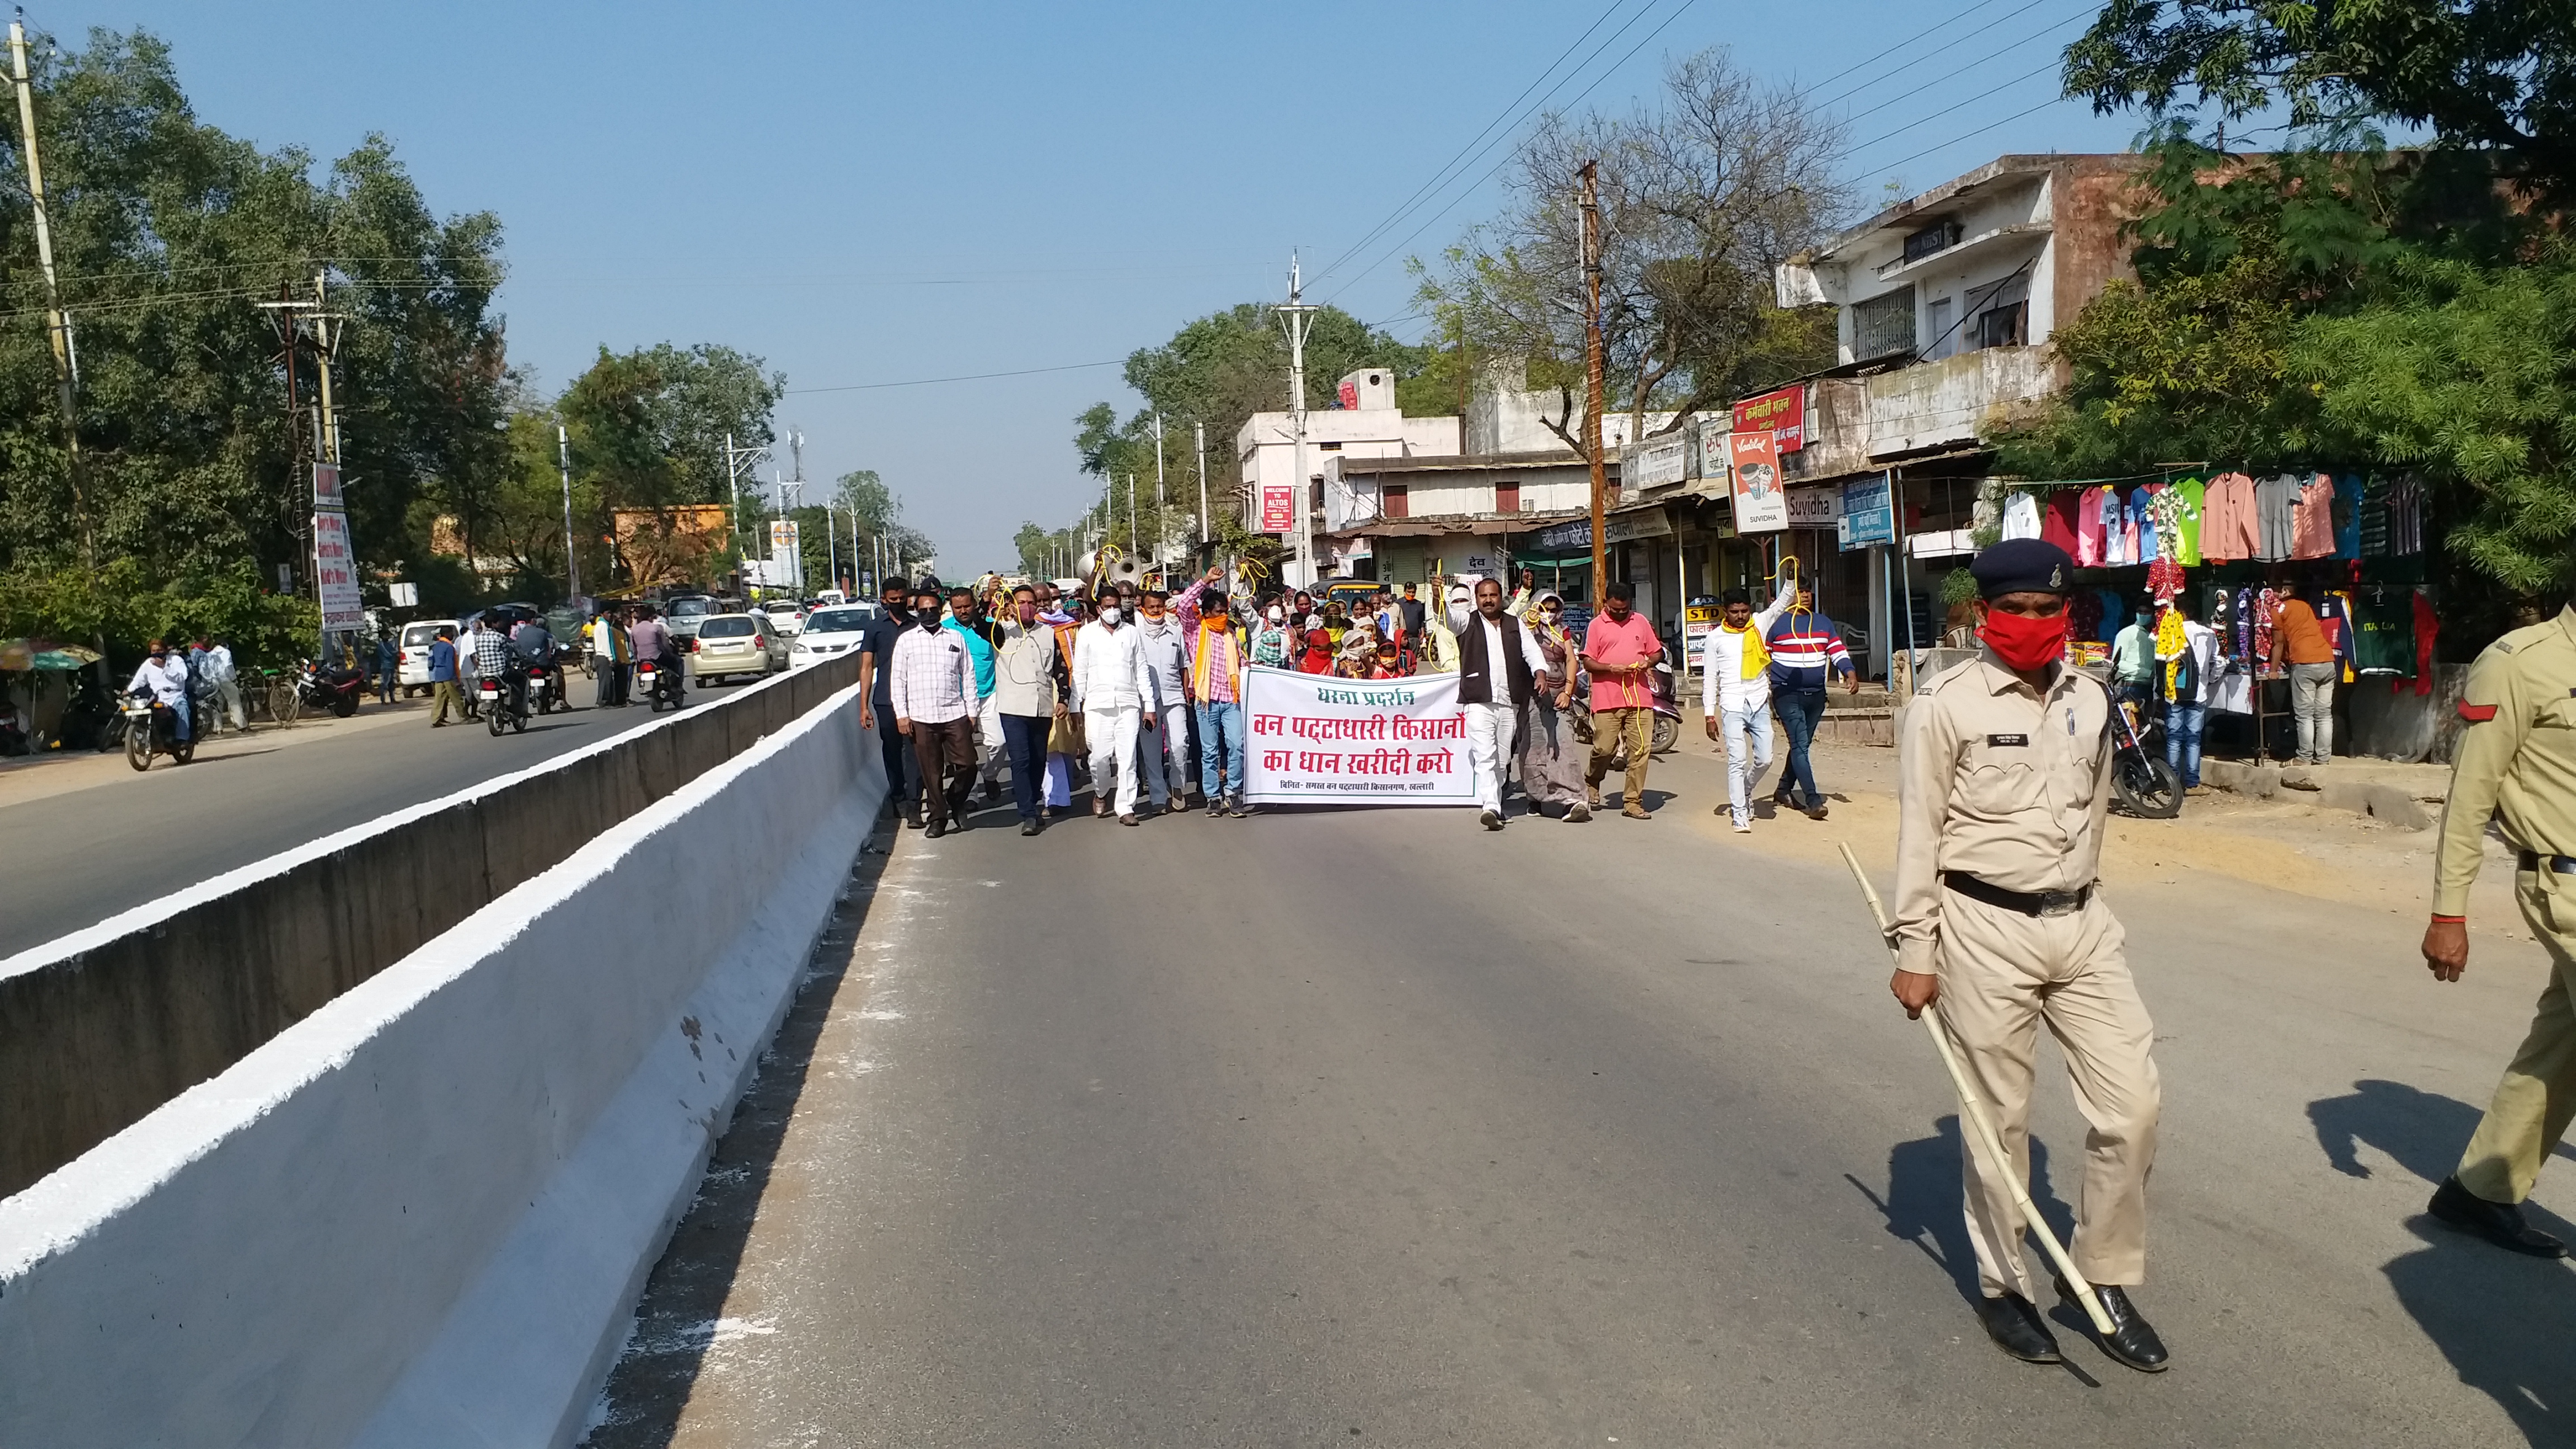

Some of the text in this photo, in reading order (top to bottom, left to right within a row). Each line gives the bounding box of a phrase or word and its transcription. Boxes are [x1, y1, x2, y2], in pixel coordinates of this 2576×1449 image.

[1745, 397, 1790, 421] कर्मचारी भवन
[1737, 437, 1767, 453] Vadilal
[1790, 494, 1830, 517] Suvidha
[1605, 515, 1634, 540] रुपाली
[1750, 514, 1778, 523] SUVIDHA
[1568, 523, 1585, 546] फोटो
[1469, 556, 1486, 568] देव
[1690, 608, 1720, 619] STD
[1318, 687, 1415, 707] धरना प्रदर्शन
[1253, 712, 1466, 744] वन पट्टाधारी किसानों
[1263, 747, 1454, 775] का धान खरीदी करो
[1339, 783, 1369, 791] पट्टाधारी
[1371, 783, 1407, 791] किसानगण,
[1409, 782, 1434, 790] खल्लारी
